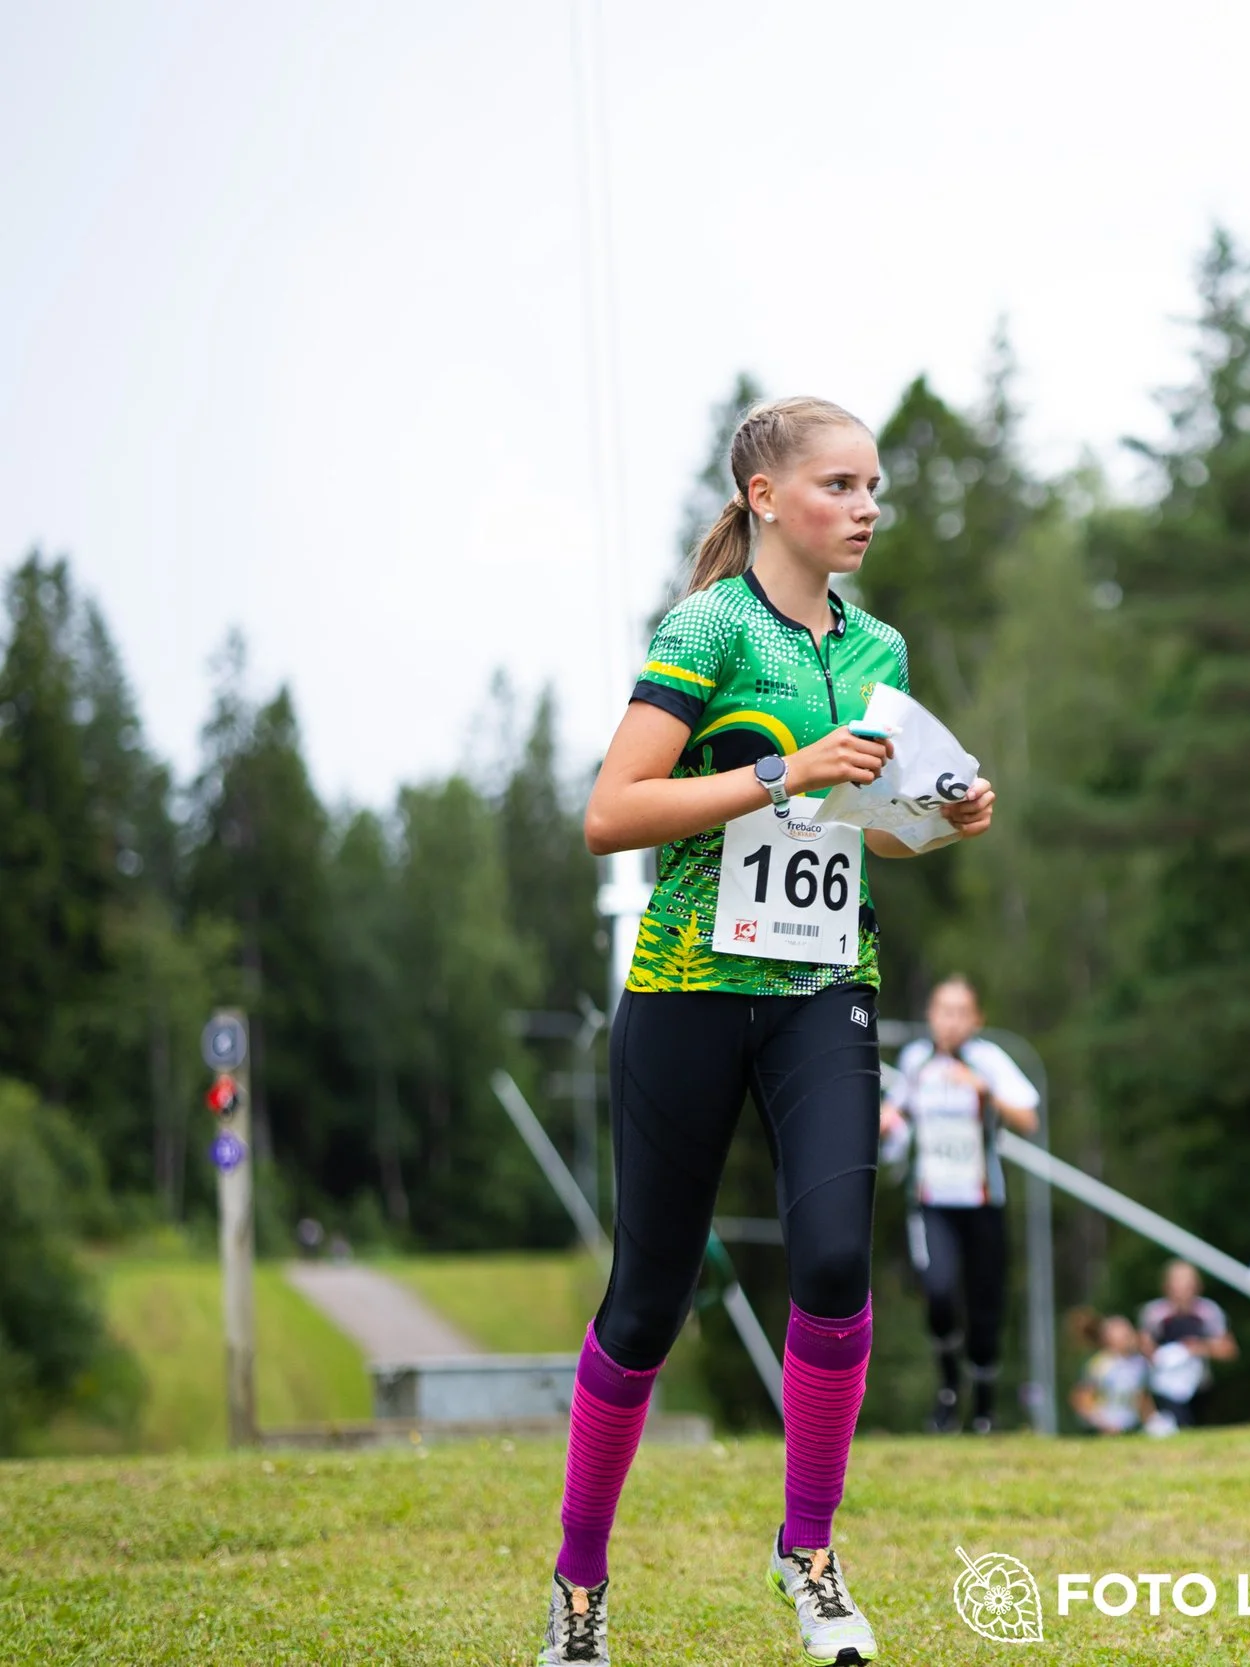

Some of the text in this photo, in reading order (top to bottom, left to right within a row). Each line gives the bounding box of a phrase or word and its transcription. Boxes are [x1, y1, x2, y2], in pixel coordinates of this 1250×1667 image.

[787, 821, 821, 832] frebaco
[743, 844, 850, 911] 166
[839, 934, 847, 954] 1
